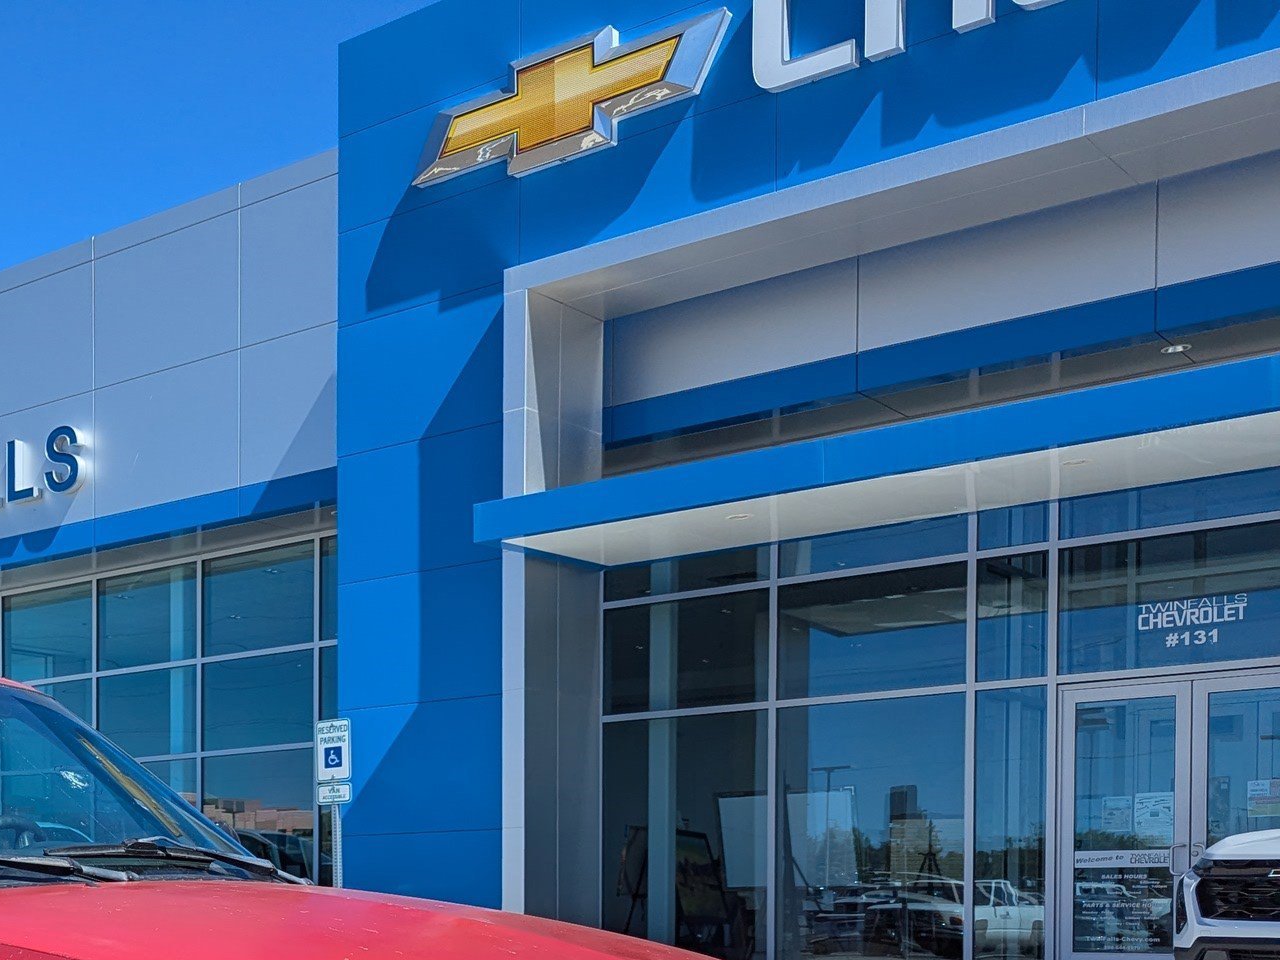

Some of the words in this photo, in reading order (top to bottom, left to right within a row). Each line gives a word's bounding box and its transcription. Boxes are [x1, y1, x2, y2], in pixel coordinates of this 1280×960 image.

[1137, 602, 1248, 631] CHEVROLET
[1165, 628, 1219, 648] #131
[317, 723, 348, 735] RESERVED
[319, 734, 346, 745] PARKING
[327, 786, 341, 794] VAN
[1075, 856, 1114, 864] Welcome
